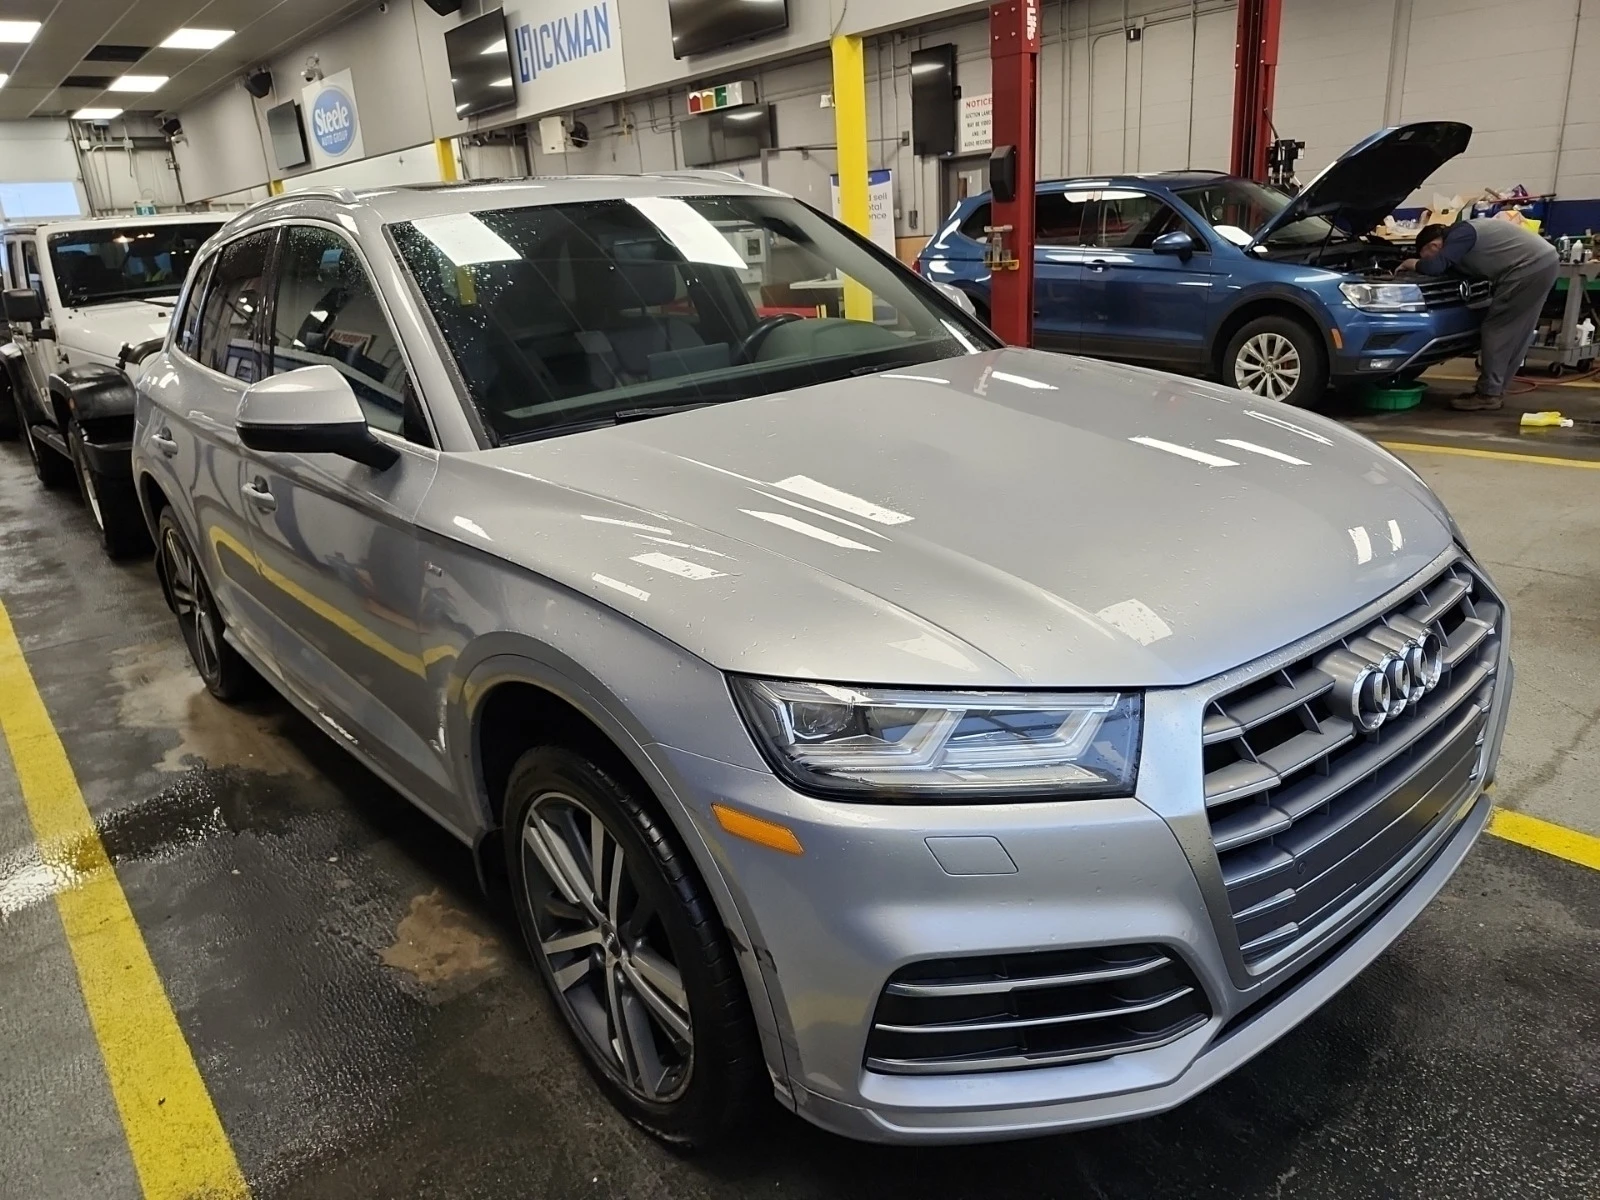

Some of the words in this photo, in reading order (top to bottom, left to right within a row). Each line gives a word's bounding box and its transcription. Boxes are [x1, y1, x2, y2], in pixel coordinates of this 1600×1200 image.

[515, 2, 610, 83] HICKMAN
[966, 98, 992, 108] NOTICE
[315, 101, 350, 136] Steele
[873, 192, 888, 201] sell
